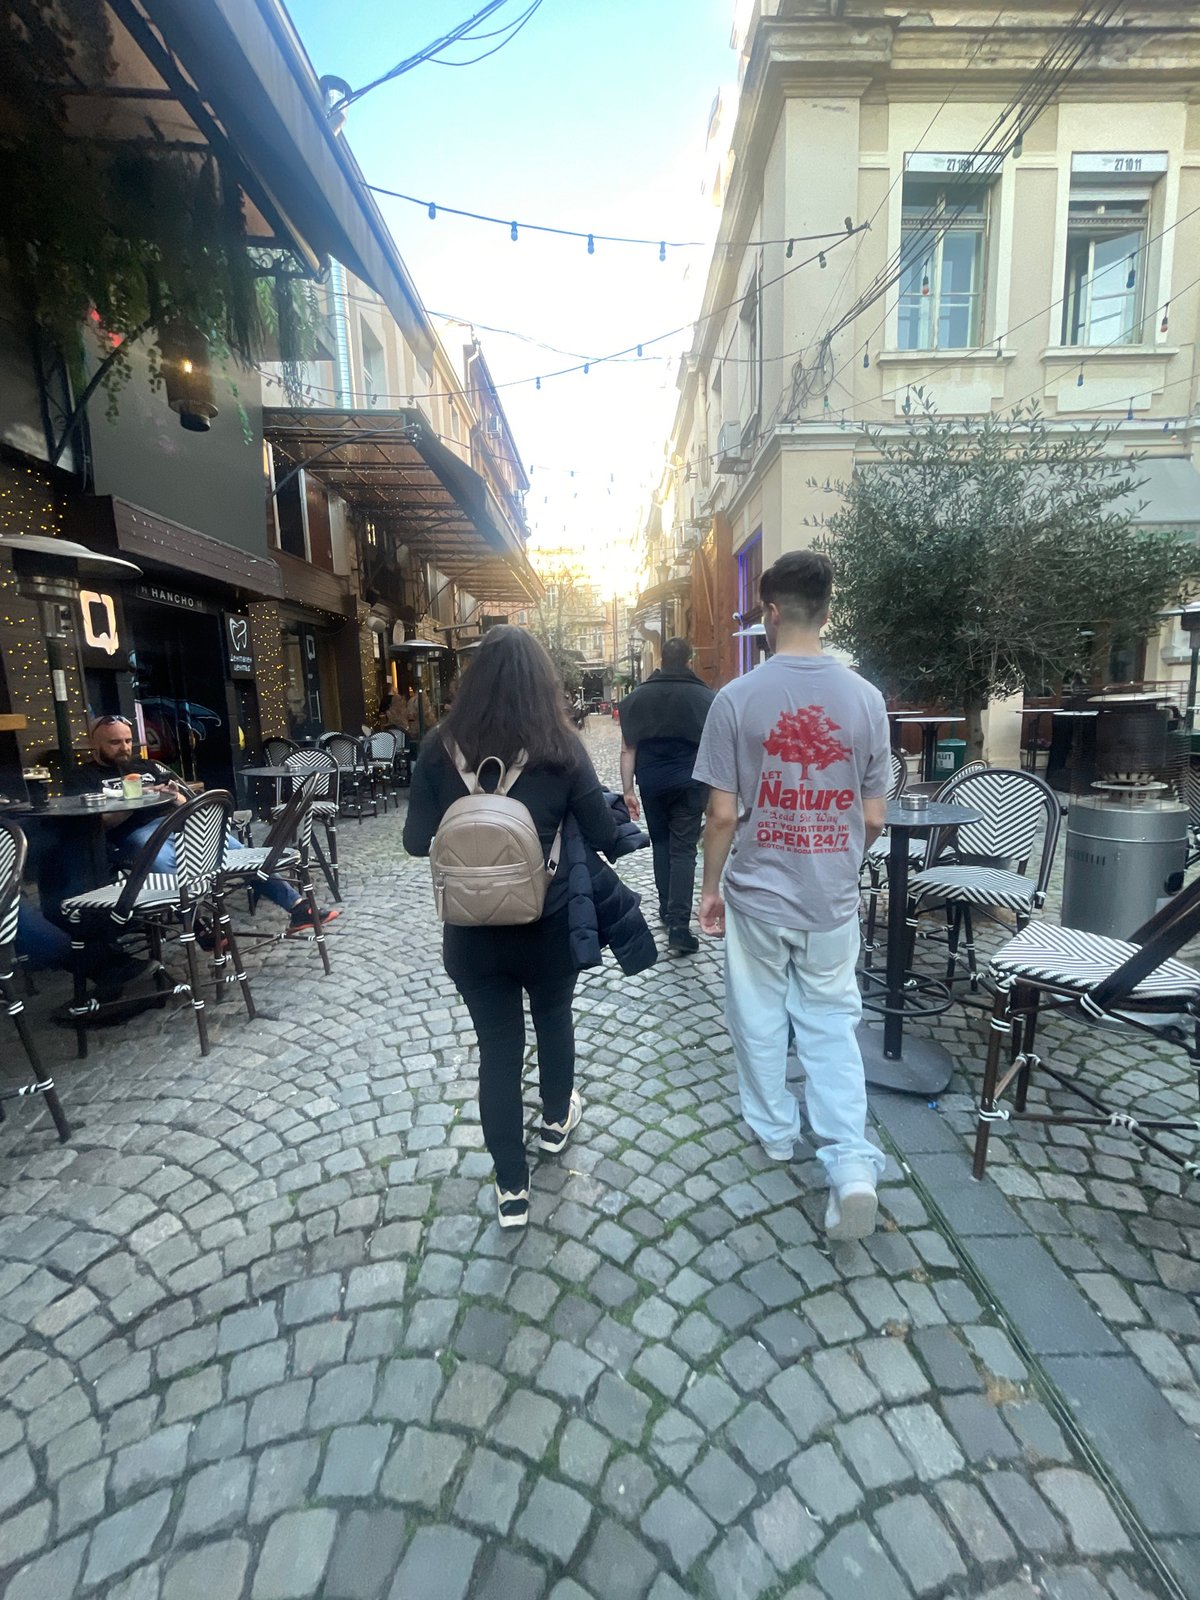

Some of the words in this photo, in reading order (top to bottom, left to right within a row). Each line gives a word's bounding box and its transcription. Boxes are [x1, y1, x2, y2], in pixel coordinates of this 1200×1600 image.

[1114, 158, 1124, 171] 27
[1125, 158, 1134, 171] 10
[151, 587, 194, 608] HANCHO
[80, 590, 119, 656] Q
[762, 771, 782, 780] LET
[758, 780, 854, 811] Nature
[758, 821, 778, 829] GET
[780, 822, 807, 833] YOUR
[756, 829, 810, 848] OPEN
[813, 833, 850, 847] 24/7
